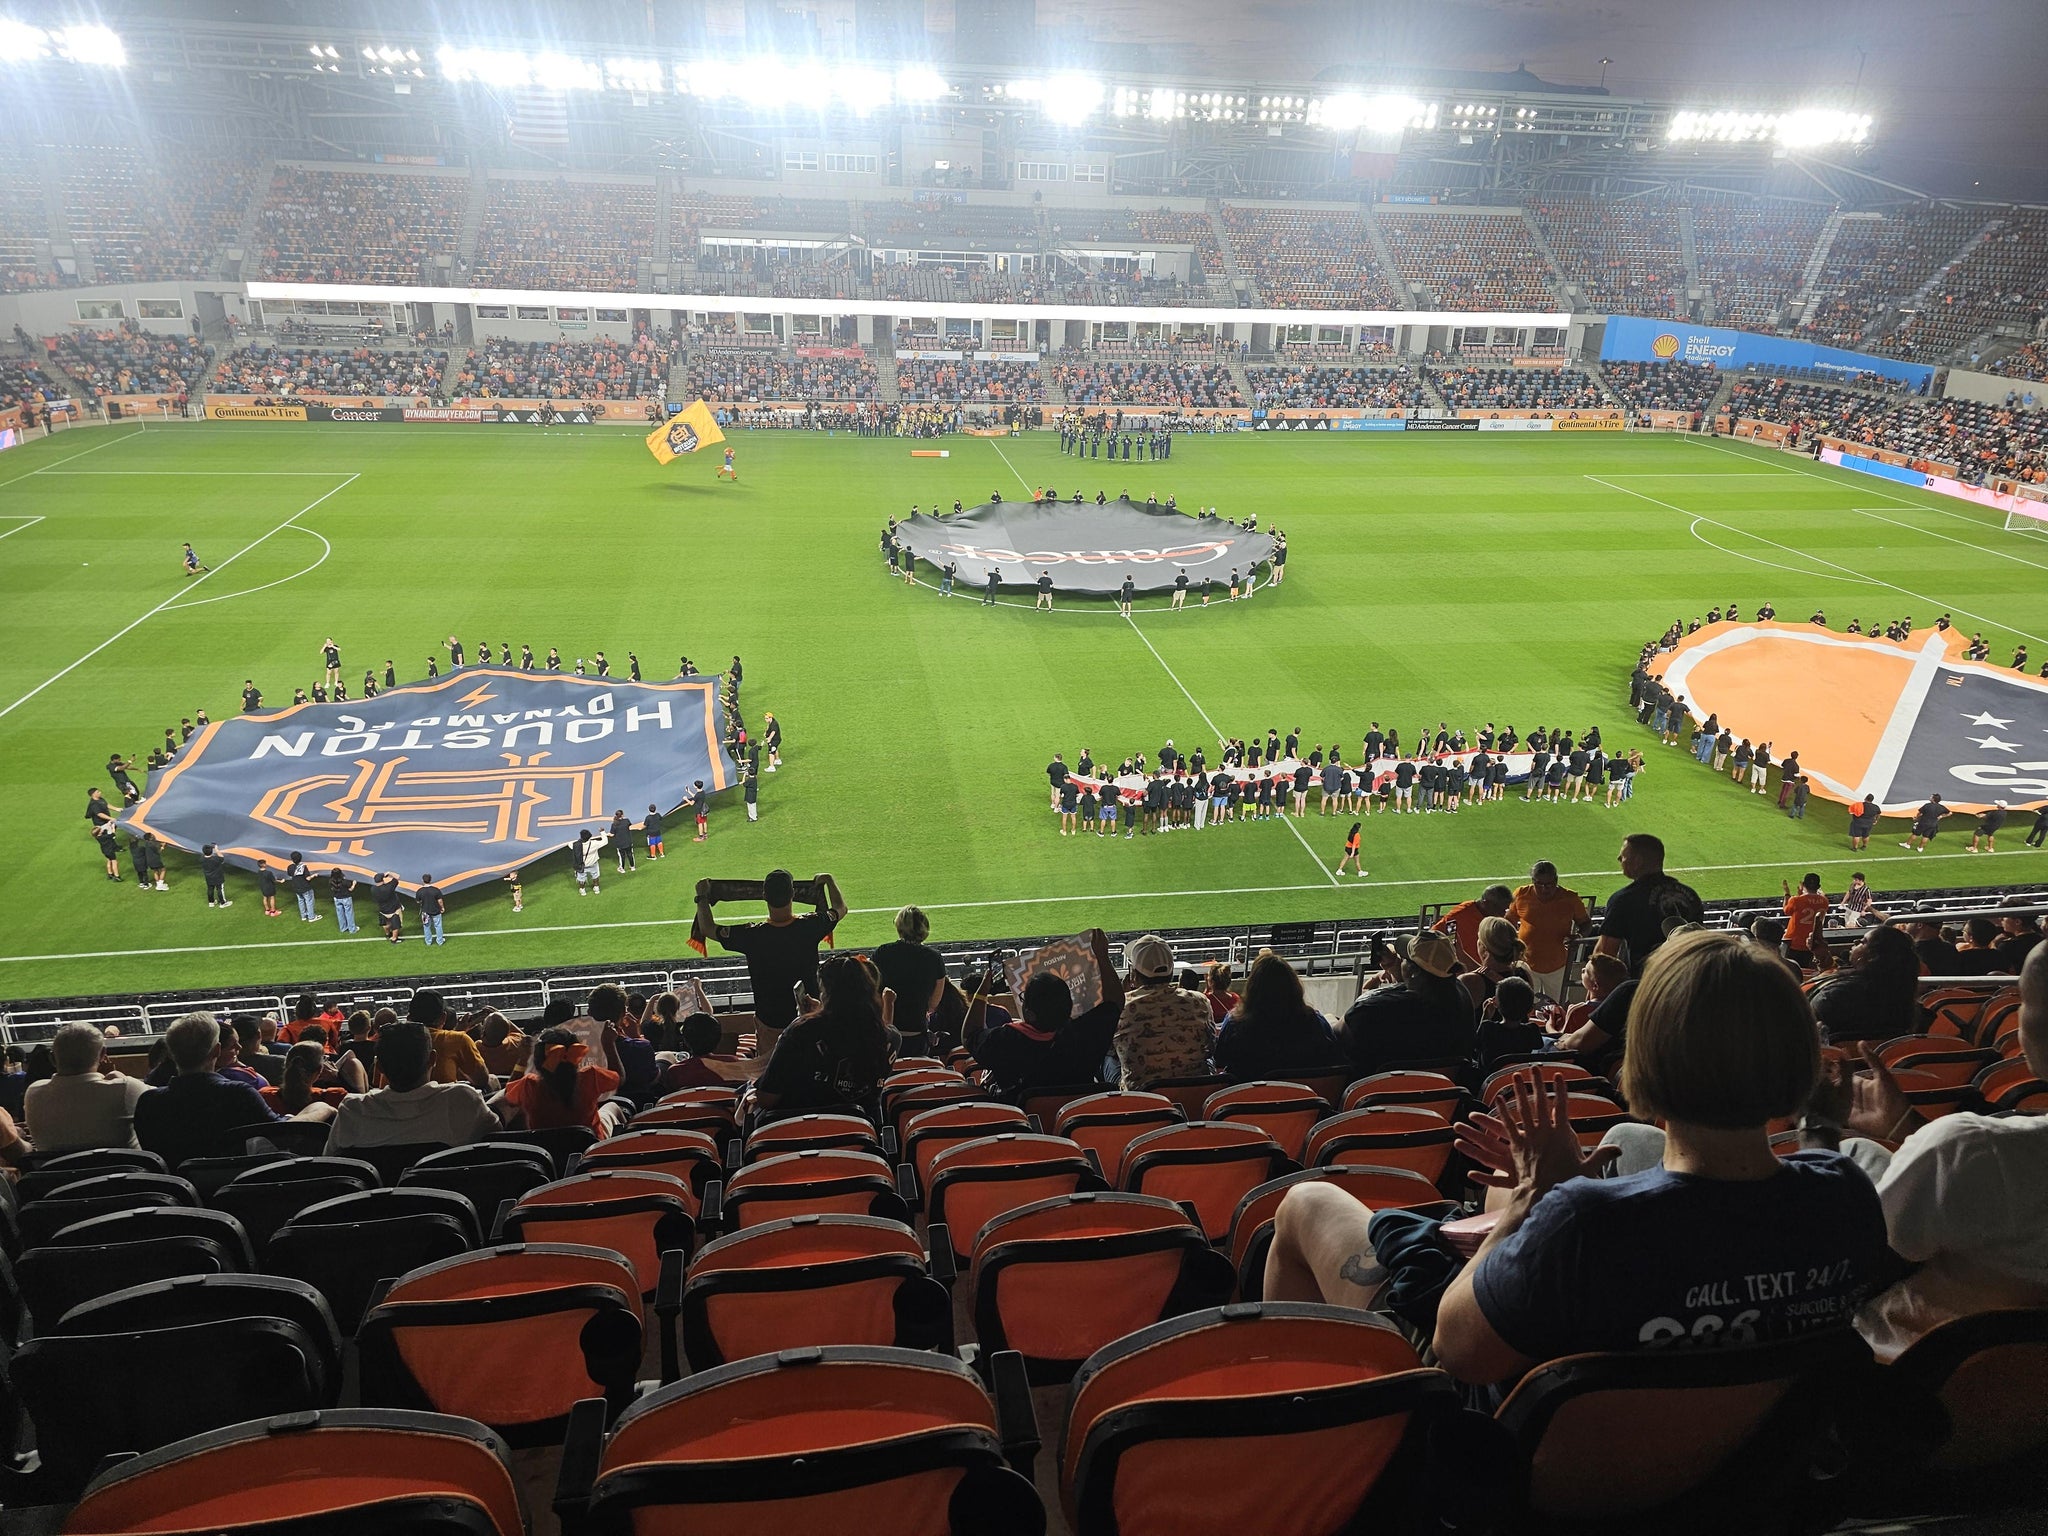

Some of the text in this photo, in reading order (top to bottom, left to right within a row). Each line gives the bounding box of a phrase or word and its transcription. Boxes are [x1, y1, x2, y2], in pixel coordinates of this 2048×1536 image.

[1687, 335, 1710, 344] Shell
[1685, 344, 1736, 357] ENERGY
[215, 407, 300, 419] Continental Tire
[331, 408, 379, 421] Cancer
[404, 409, 481, 419] DYNAMOLAWYER.COM
[1558, 420, 1620, 430] Continental Tire
[947, 541, 1229, 567] Cancer
[336, 692, 614, 734] DYNAMO FC
[249, 701, 675, 760] HOUSTON
[1685, 1280, 1740, 1308] CALL.
[1785, 1296, 1836, 1316] SUICIDE
